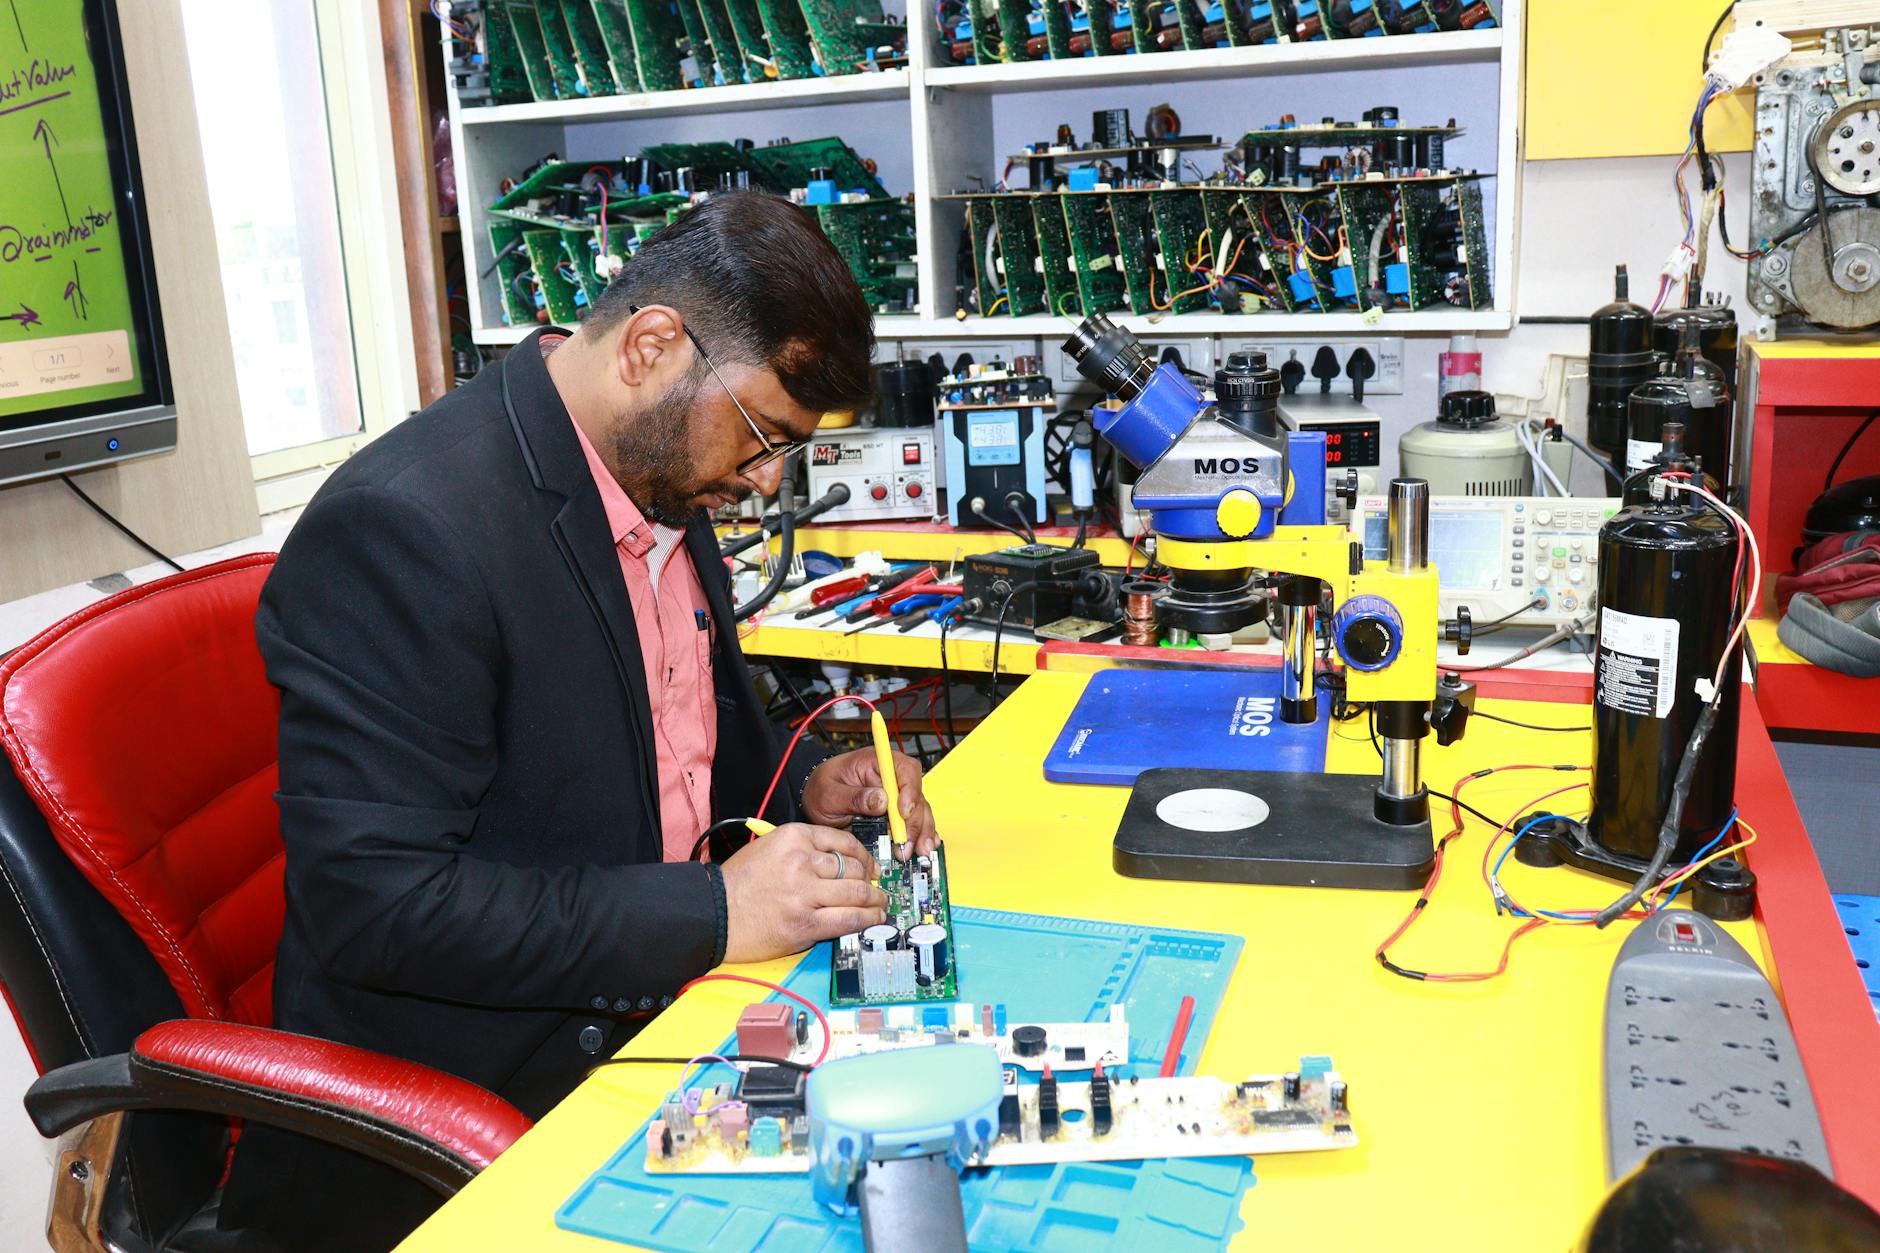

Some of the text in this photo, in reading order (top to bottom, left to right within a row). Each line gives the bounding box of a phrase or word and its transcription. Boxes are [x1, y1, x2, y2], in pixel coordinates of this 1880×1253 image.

[40, 375, 57, 384] Page
[57, 372, 81, 381] number
[840, 450, 861, 459] Tools
[1194, 457, 1260, 475] MOS
[1239, 696, 1276, 737] MOS
